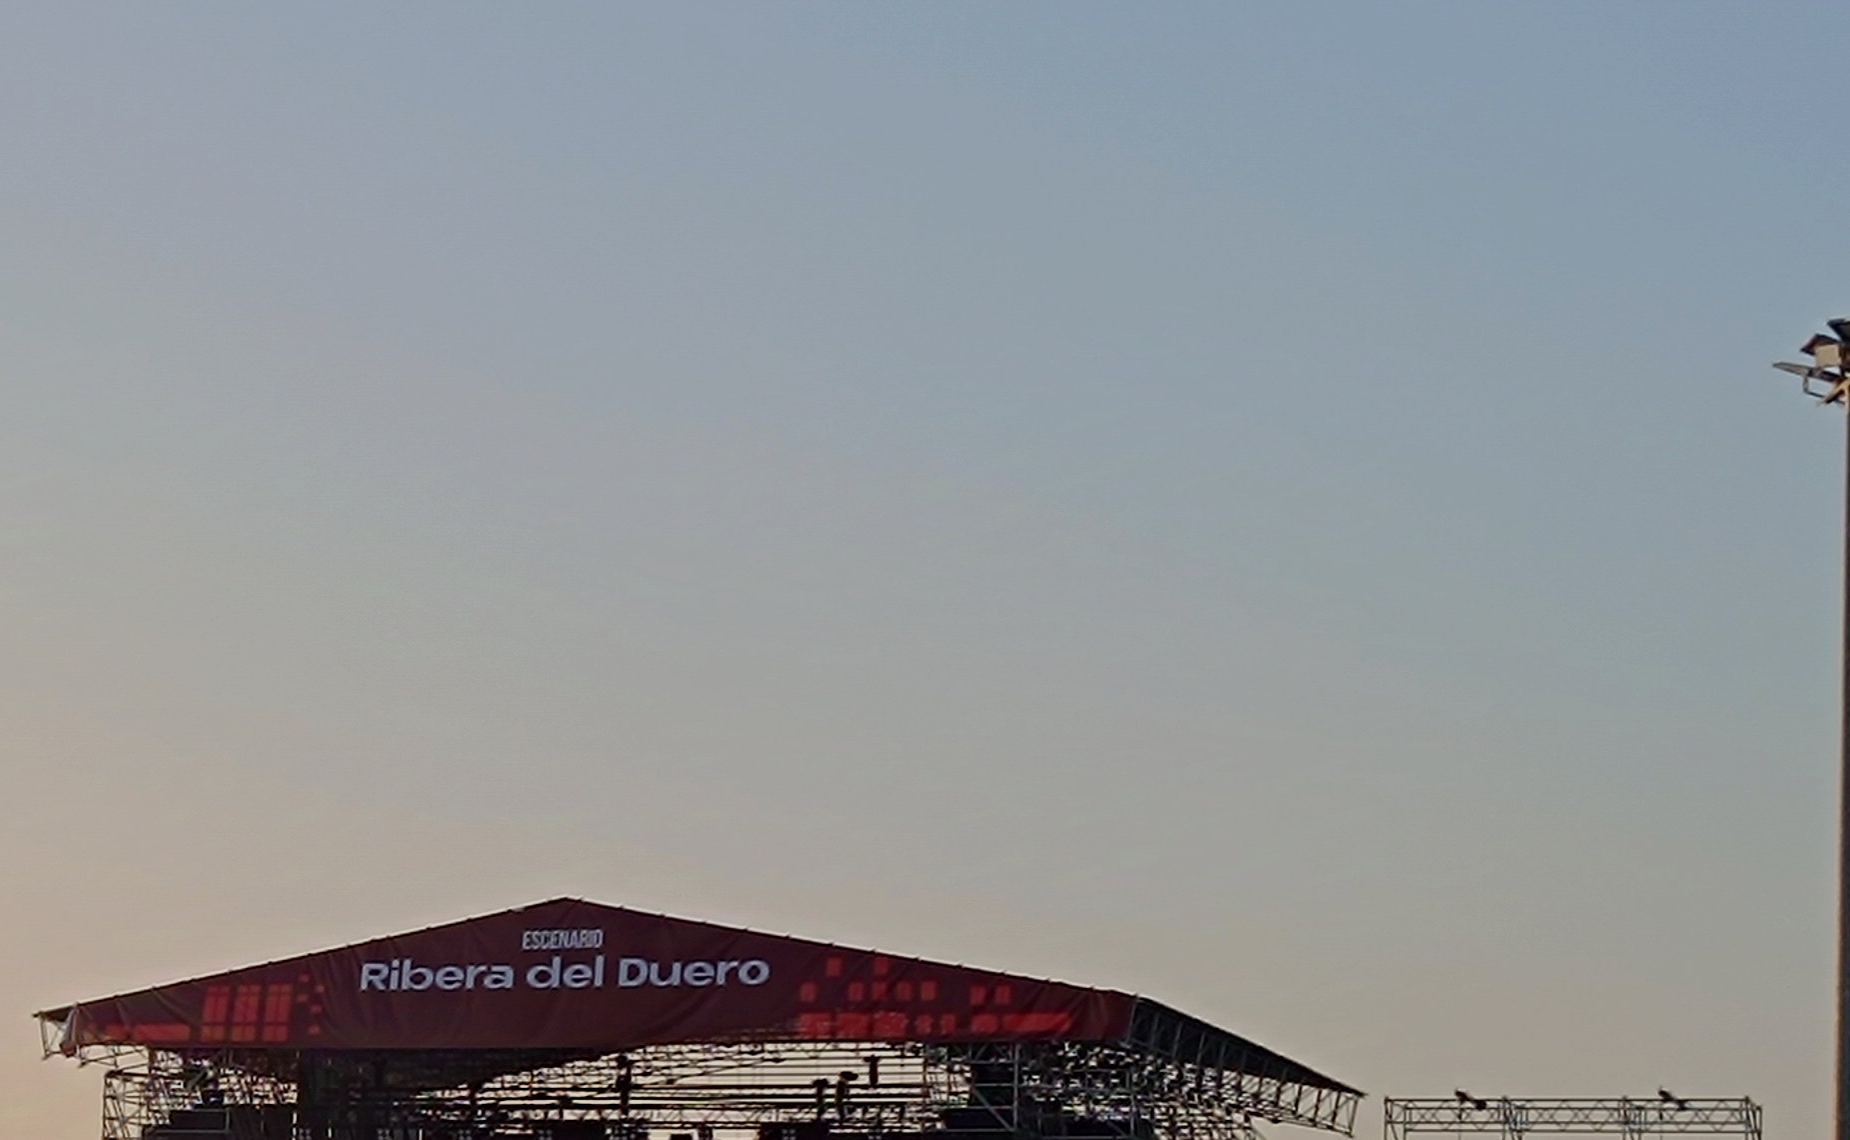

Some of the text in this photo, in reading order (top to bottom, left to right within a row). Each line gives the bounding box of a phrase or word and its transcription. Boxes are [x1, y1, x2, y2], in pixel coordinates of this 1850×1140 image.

[521, 928, 604, 951] ESCENARIO
[359, 955, 771, 992] Ribera del Duero
